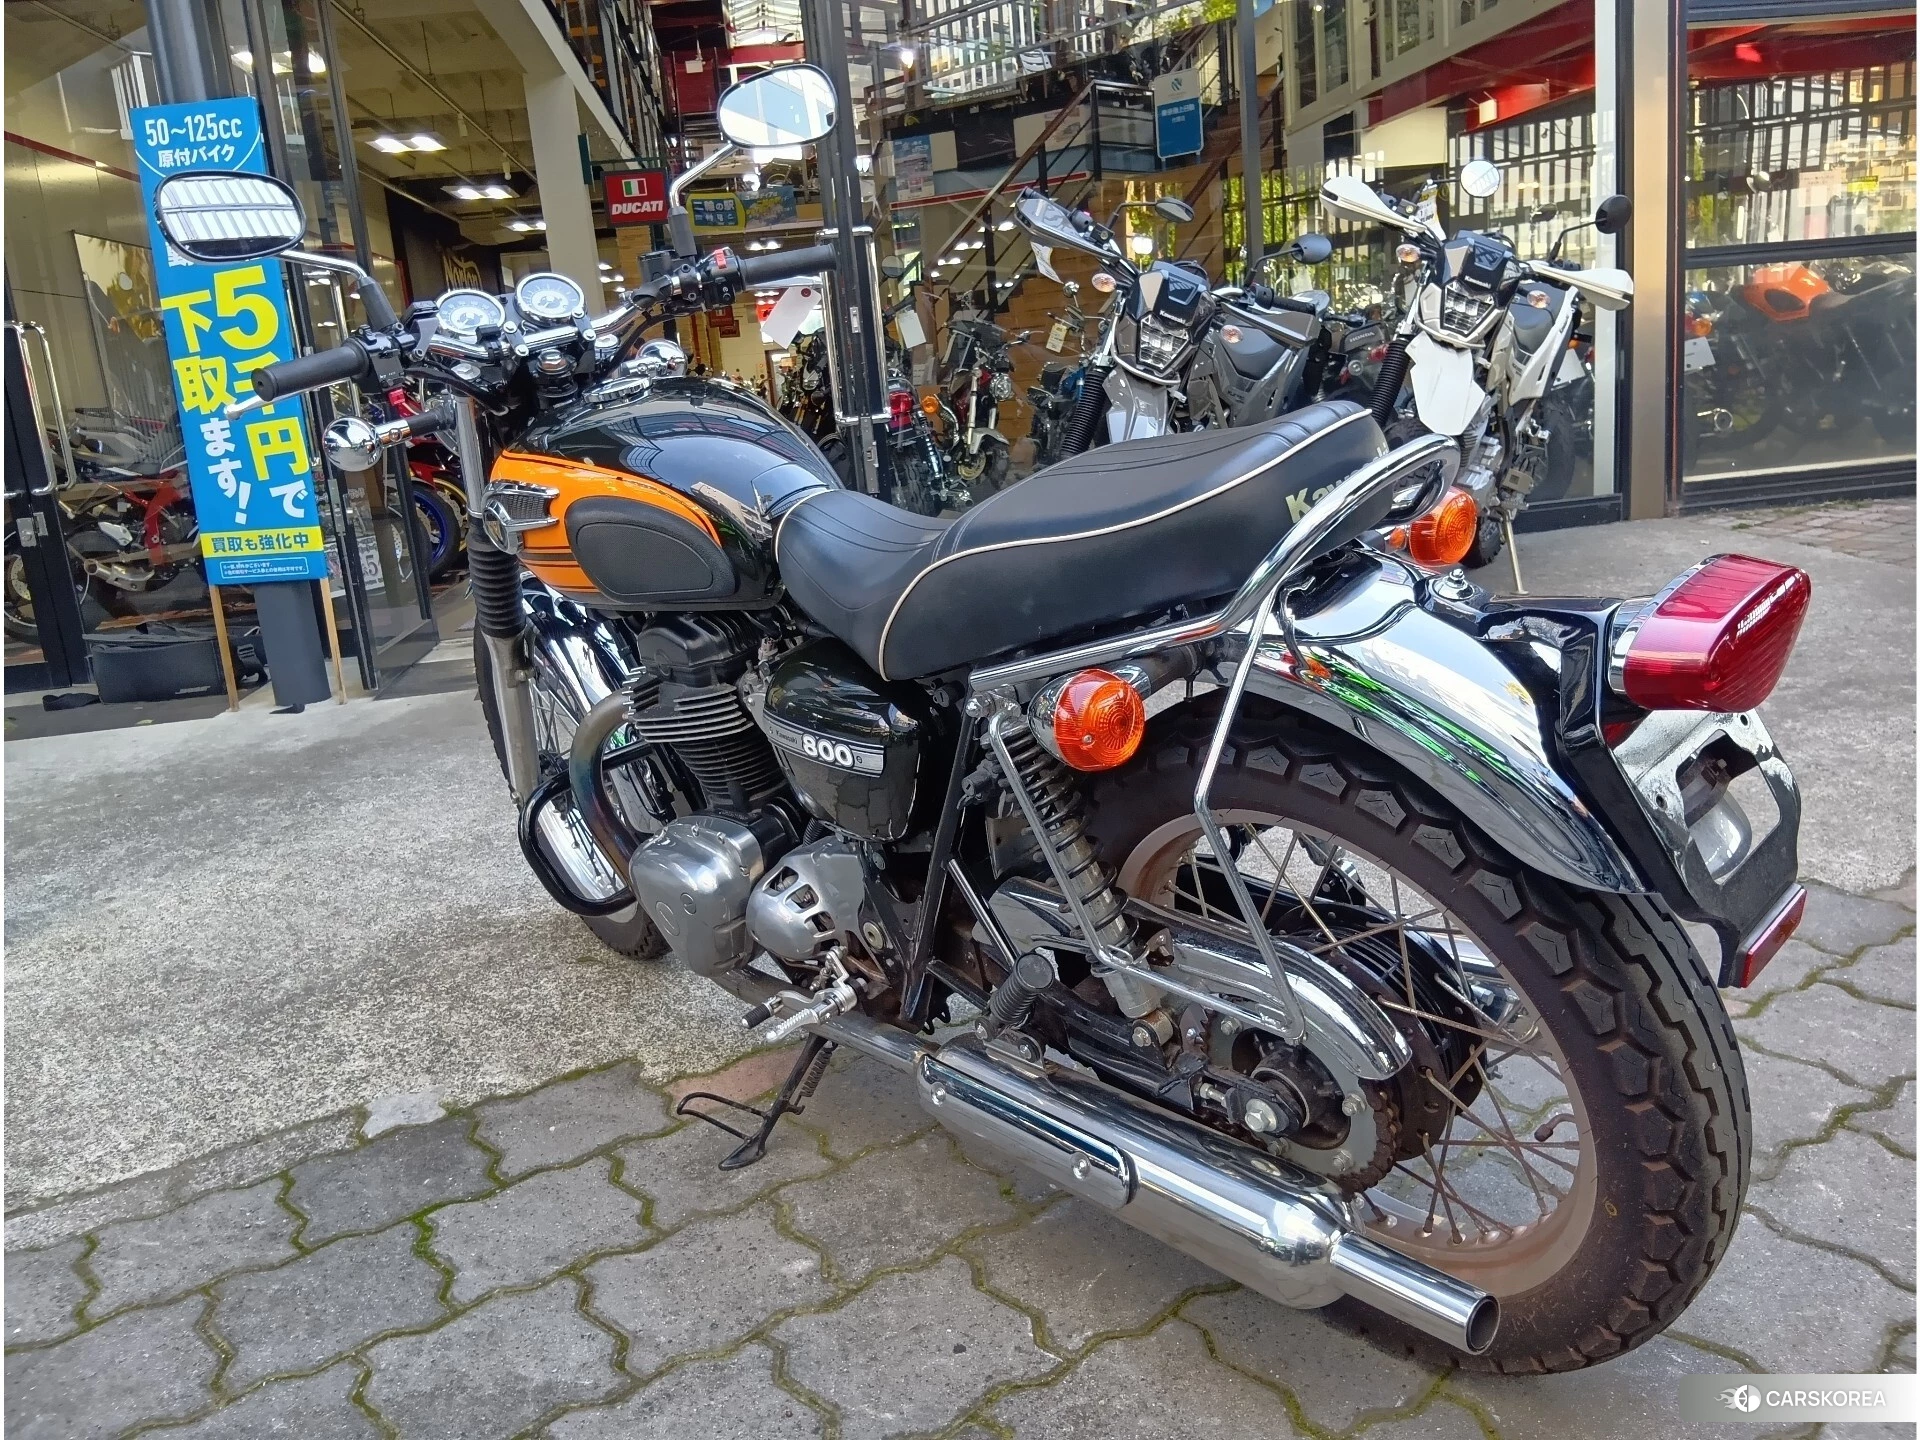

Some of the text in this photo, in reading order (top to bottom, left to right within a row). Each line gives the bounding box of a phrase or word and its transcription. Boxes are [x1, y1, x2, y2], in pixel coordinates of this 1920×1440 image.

[158, 143, 235, 168] 原付バイク
[611, 201, 663, 215] DUCATI
[1350, 331, 1375, 342] HONDA
[211, 532, 309, 553] 買取も強化中
[802, 733, 854, 767] 800
